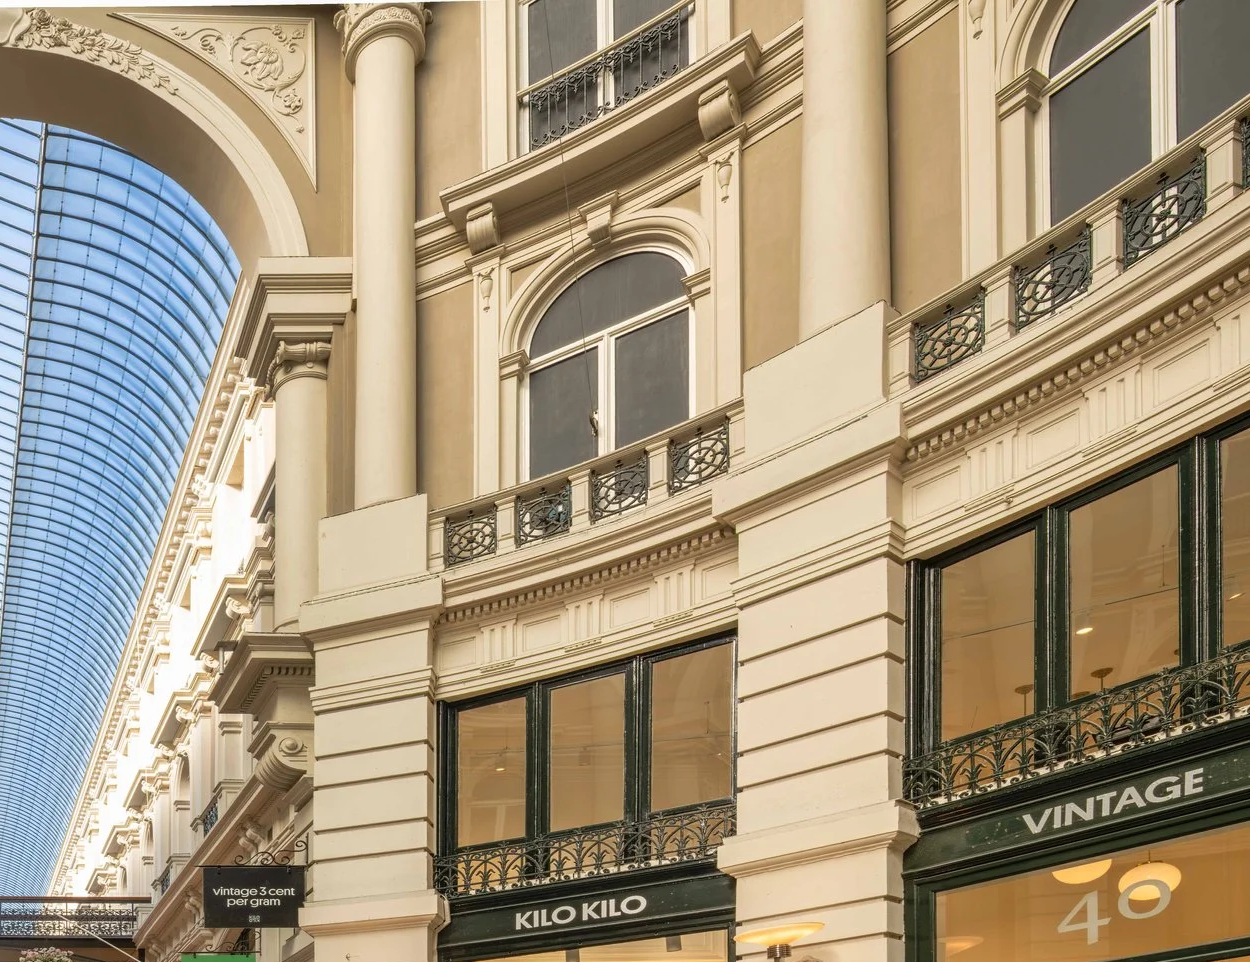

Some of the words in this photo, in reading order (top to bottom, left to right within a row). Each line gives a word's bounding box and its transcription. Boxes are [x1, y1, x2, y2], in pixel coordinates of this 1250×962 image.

[1022, 768, 1204, 835] VINTAGE
[213, 887, 258, 898] vintage
[260, 887, 267, 896] 3
[269, 887, 295, 896] cent
[227, 899, 248, 908] per
[250, 898, 281, 908] gram
[515, 906, 577, 931] KILO
[582, 895, 648, 922] KILO
[1057, 879, 1172, 946] 40
